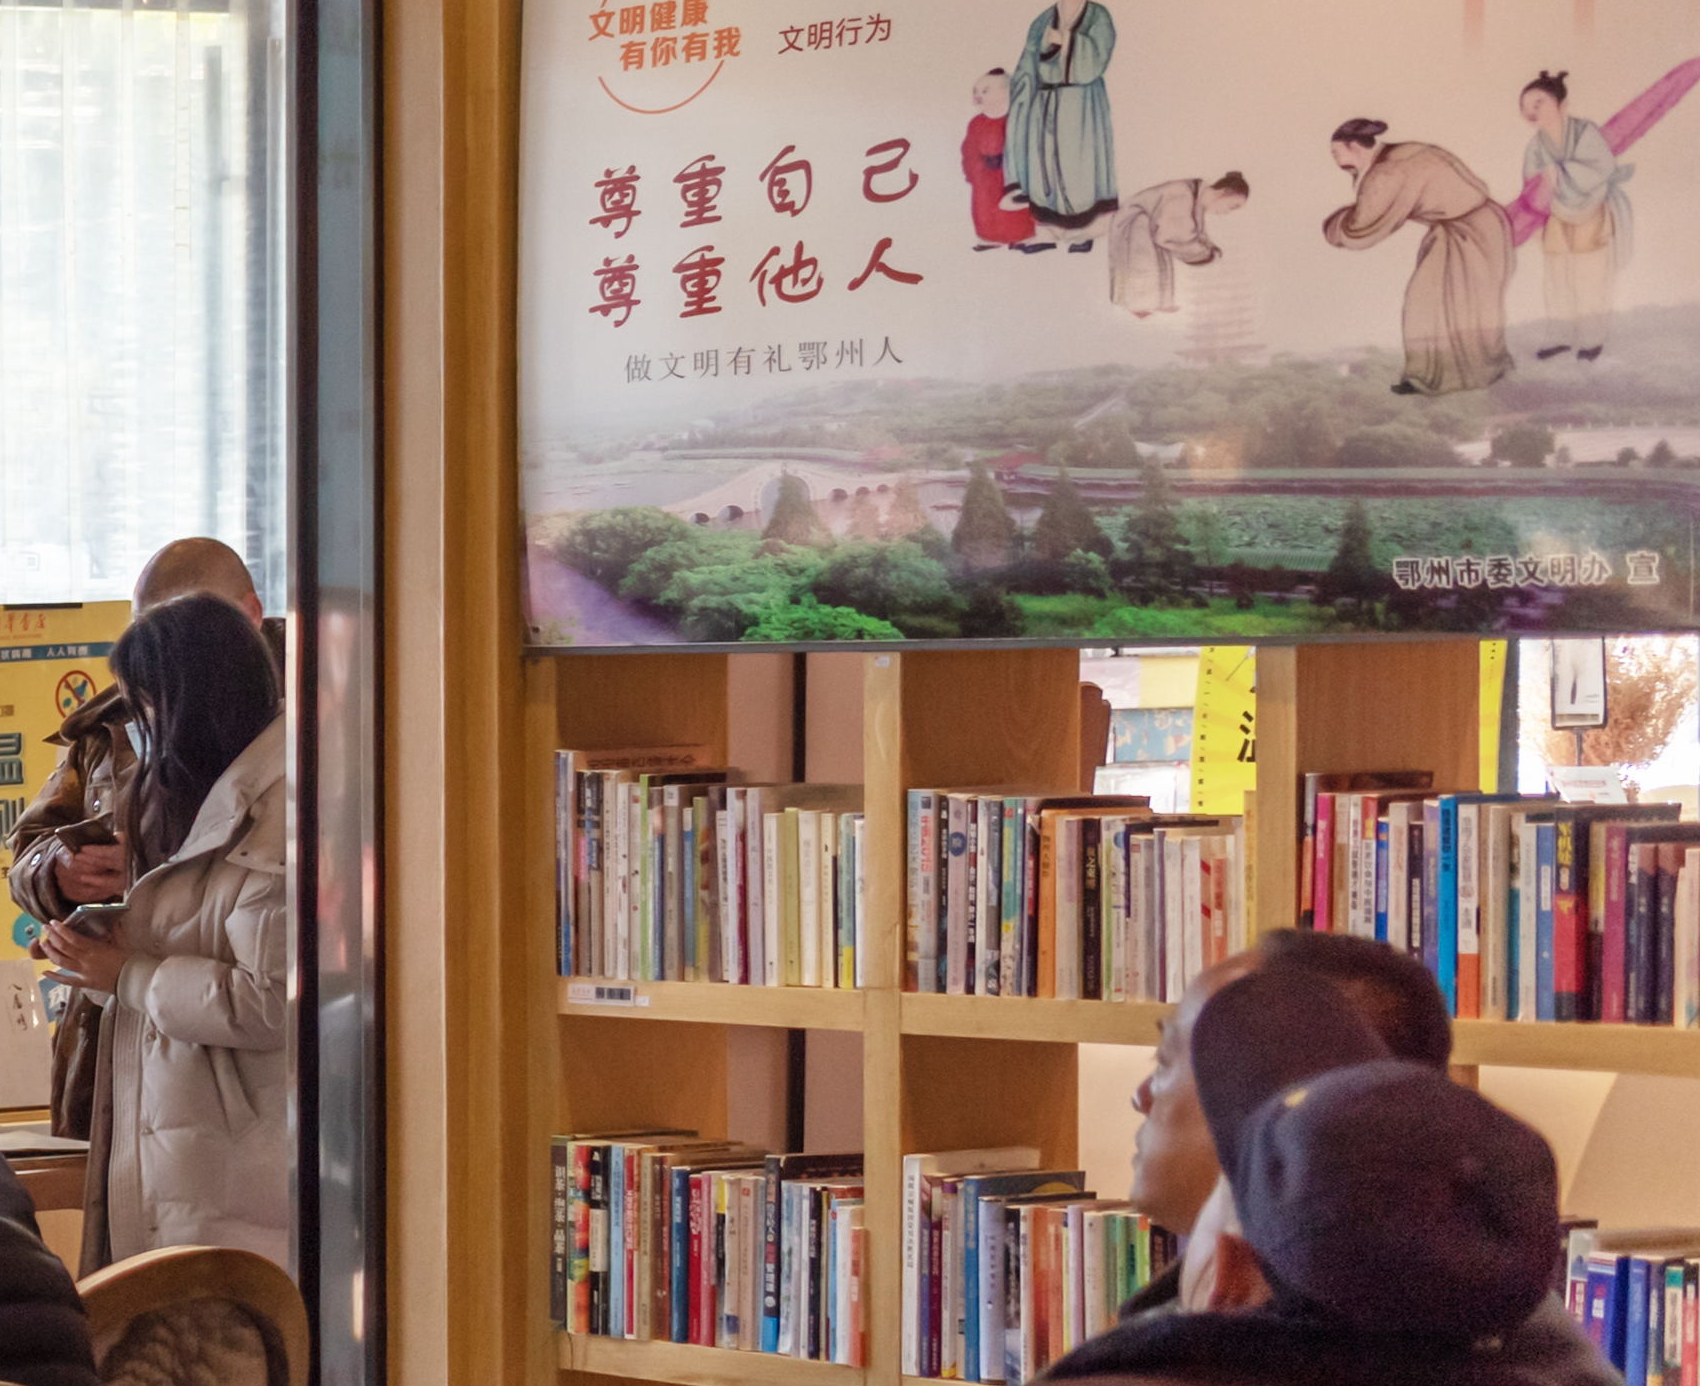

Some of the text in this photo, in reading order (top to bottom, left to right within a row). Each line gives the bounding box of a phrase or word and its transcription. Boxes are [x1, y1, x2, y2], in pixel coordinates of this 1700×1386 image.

[619, 26, 742, 72] 有你有我
[778, 13, 892, 55] 文明行为
[588, 137, 920, 239] 尊重自己
[588, 237, 924, 328] 尊重他人
[624, 335, 904, 384] 做文明有礼鄂州人
[1394, 550, 1660, 589] 鄂州市委文明办 宣
